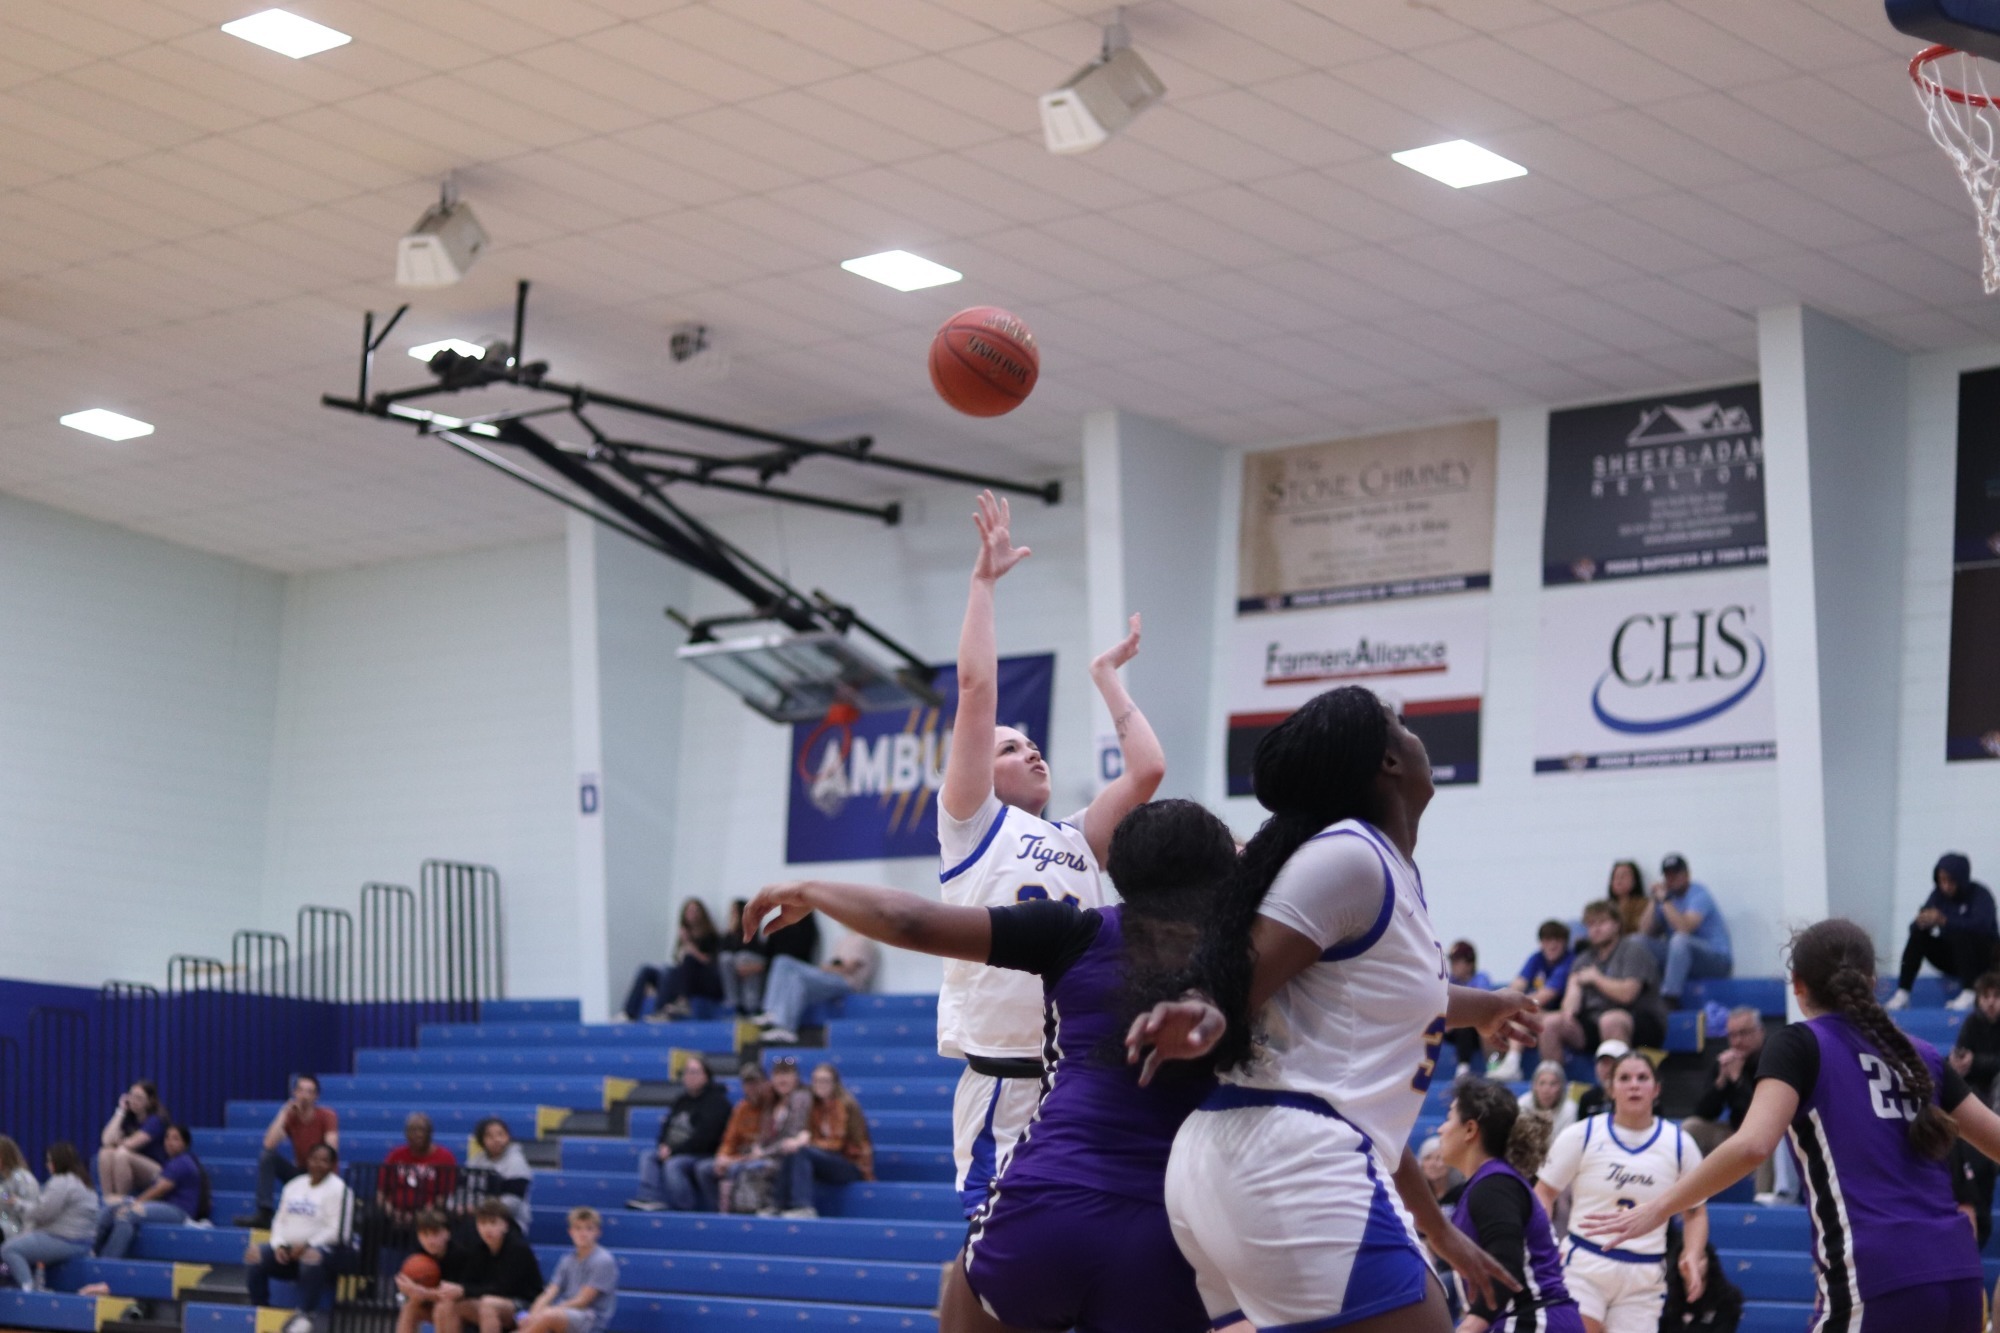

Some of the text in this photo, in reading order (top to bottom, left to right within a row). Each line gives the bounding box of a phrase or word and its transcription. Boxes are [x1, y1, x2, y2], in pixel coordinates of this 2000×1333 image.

[1611, 604, 1749, 688] CHS
[1016, 833, 1089, 872] Tigers
[1605, 1162, 1655, 1190] Tigers
